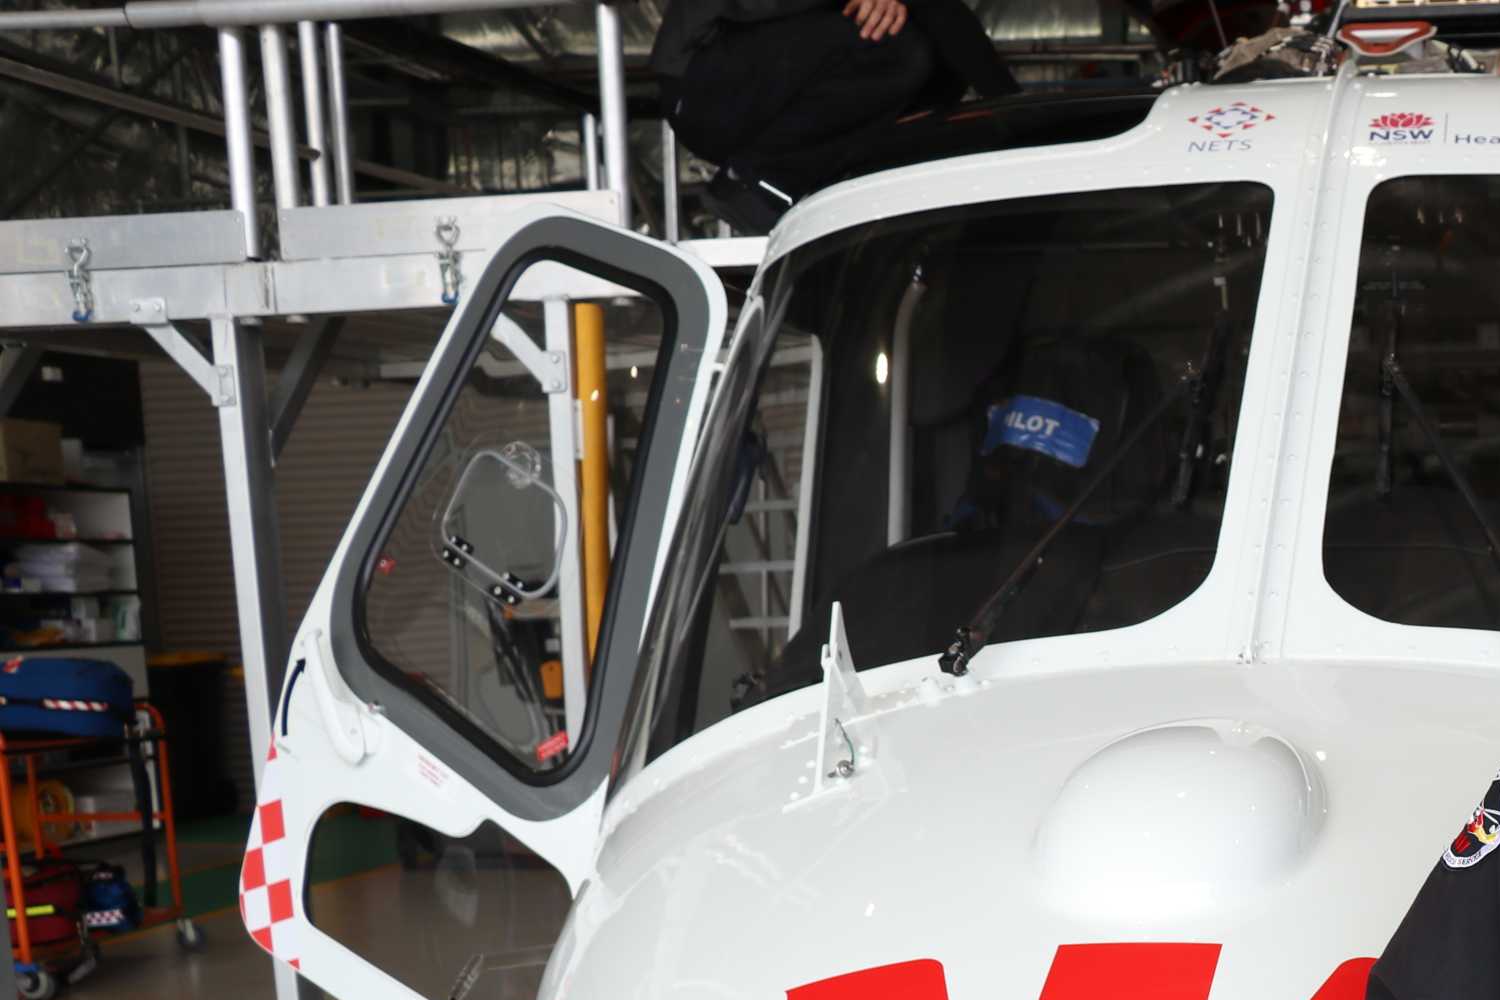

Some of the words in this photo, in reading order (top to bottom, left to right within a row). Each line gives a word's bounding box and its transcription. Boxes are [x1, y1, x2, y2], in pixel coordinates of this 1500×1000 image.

[1369, 129, 1434, 141] NSW
[1187, 140, 1252, 153] NETS
[1005, 411, 1060, 437] ILOT
